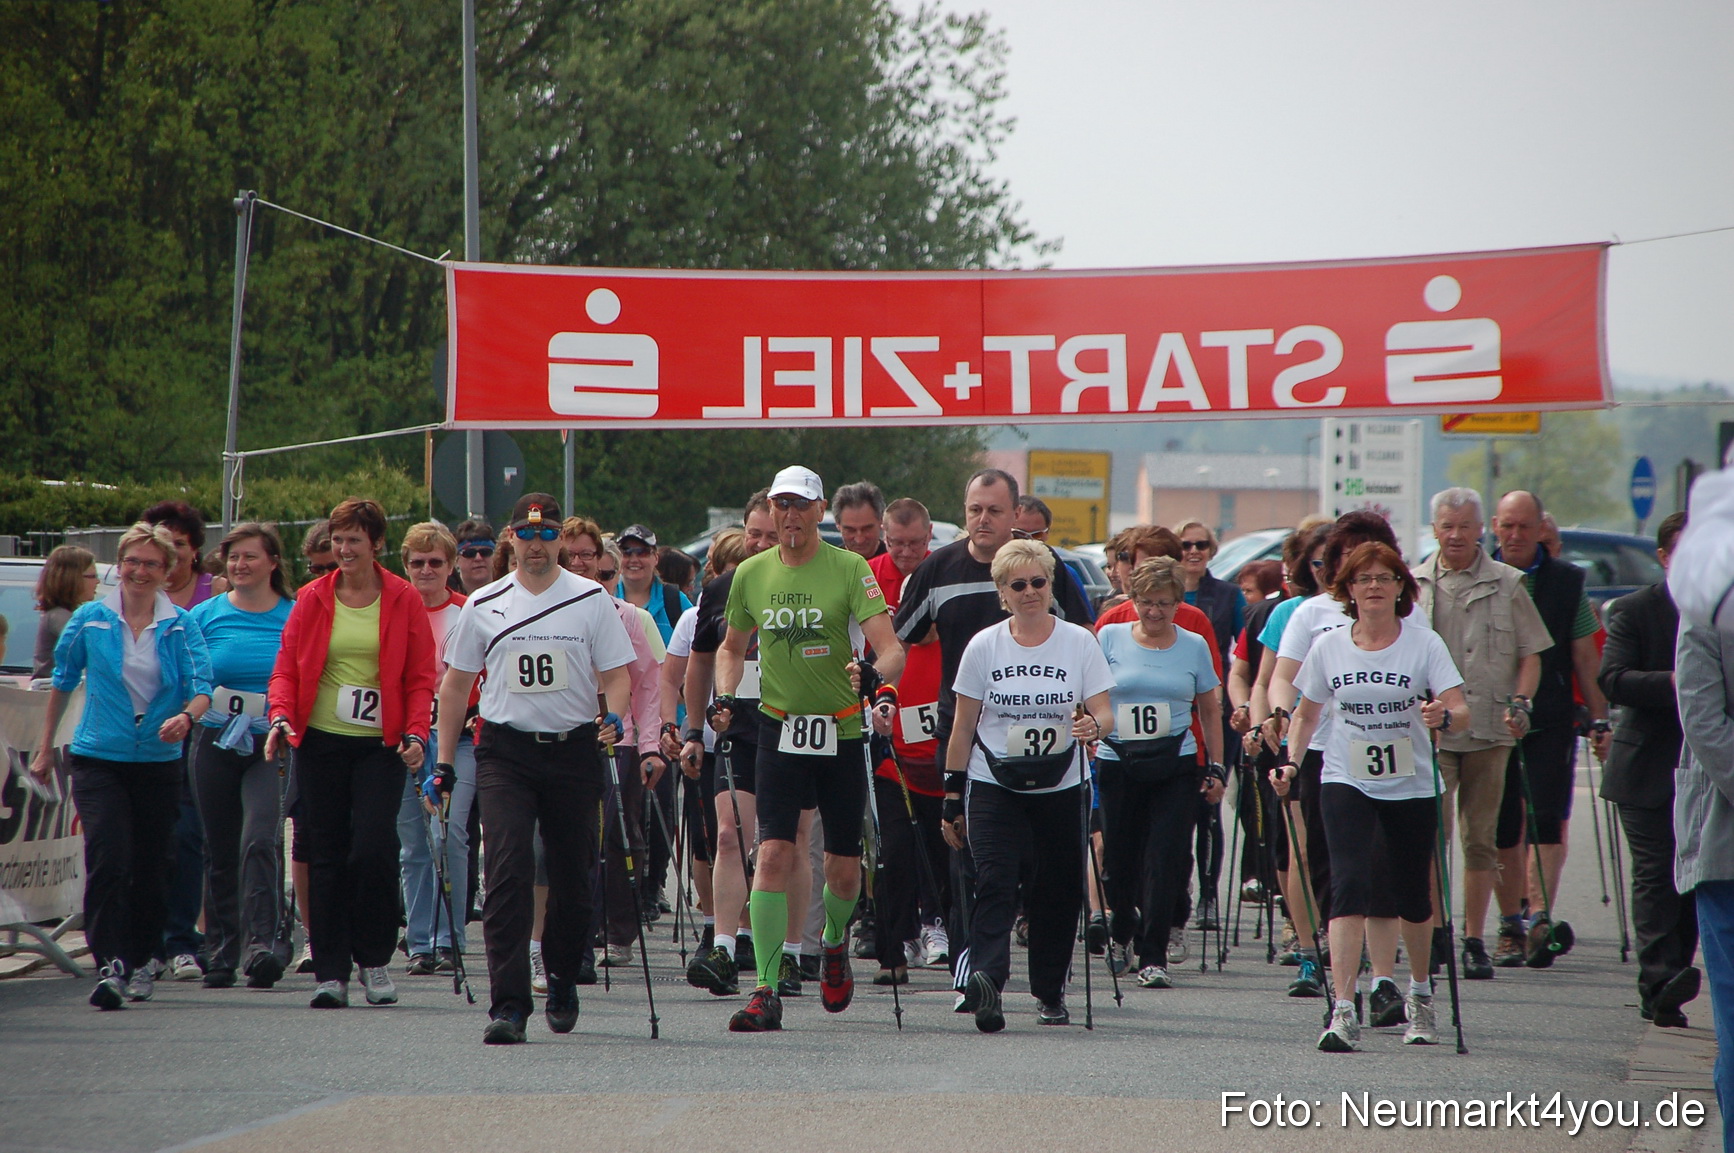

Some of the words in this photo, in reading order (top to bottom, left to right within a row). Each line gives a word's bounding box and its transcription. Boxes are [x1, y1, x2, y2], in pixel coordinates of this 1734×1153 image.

[770, 591, 812, 605] FÜRTH
[762, 607, 823, 630] 2012
[518, 653, 555, 688] 96
[991, 665, 1067, 682] BERGER
[1332, 671, 1412, 690] BERGER
[228, 695, 245, 717] 9
[351, 689, 379, 722] 12
[989, 691, 1031, 706] POWER
[1035, 691, 1074, 706] GIRLS
[1378, 696, 1416, 714] GIRLS
[917, 705, 936, 735] 5
[1038, 712, 1064, 721] talking
[1131, 705, 1158, 735] 16
[1367, 722, 1383, 730] and
[1384, 720, 1411, 730] talking
[792, 716, 827, 750] 80
[1024, 727, 1057, 756] 32
[1366, 744, 1397, 776] 31
